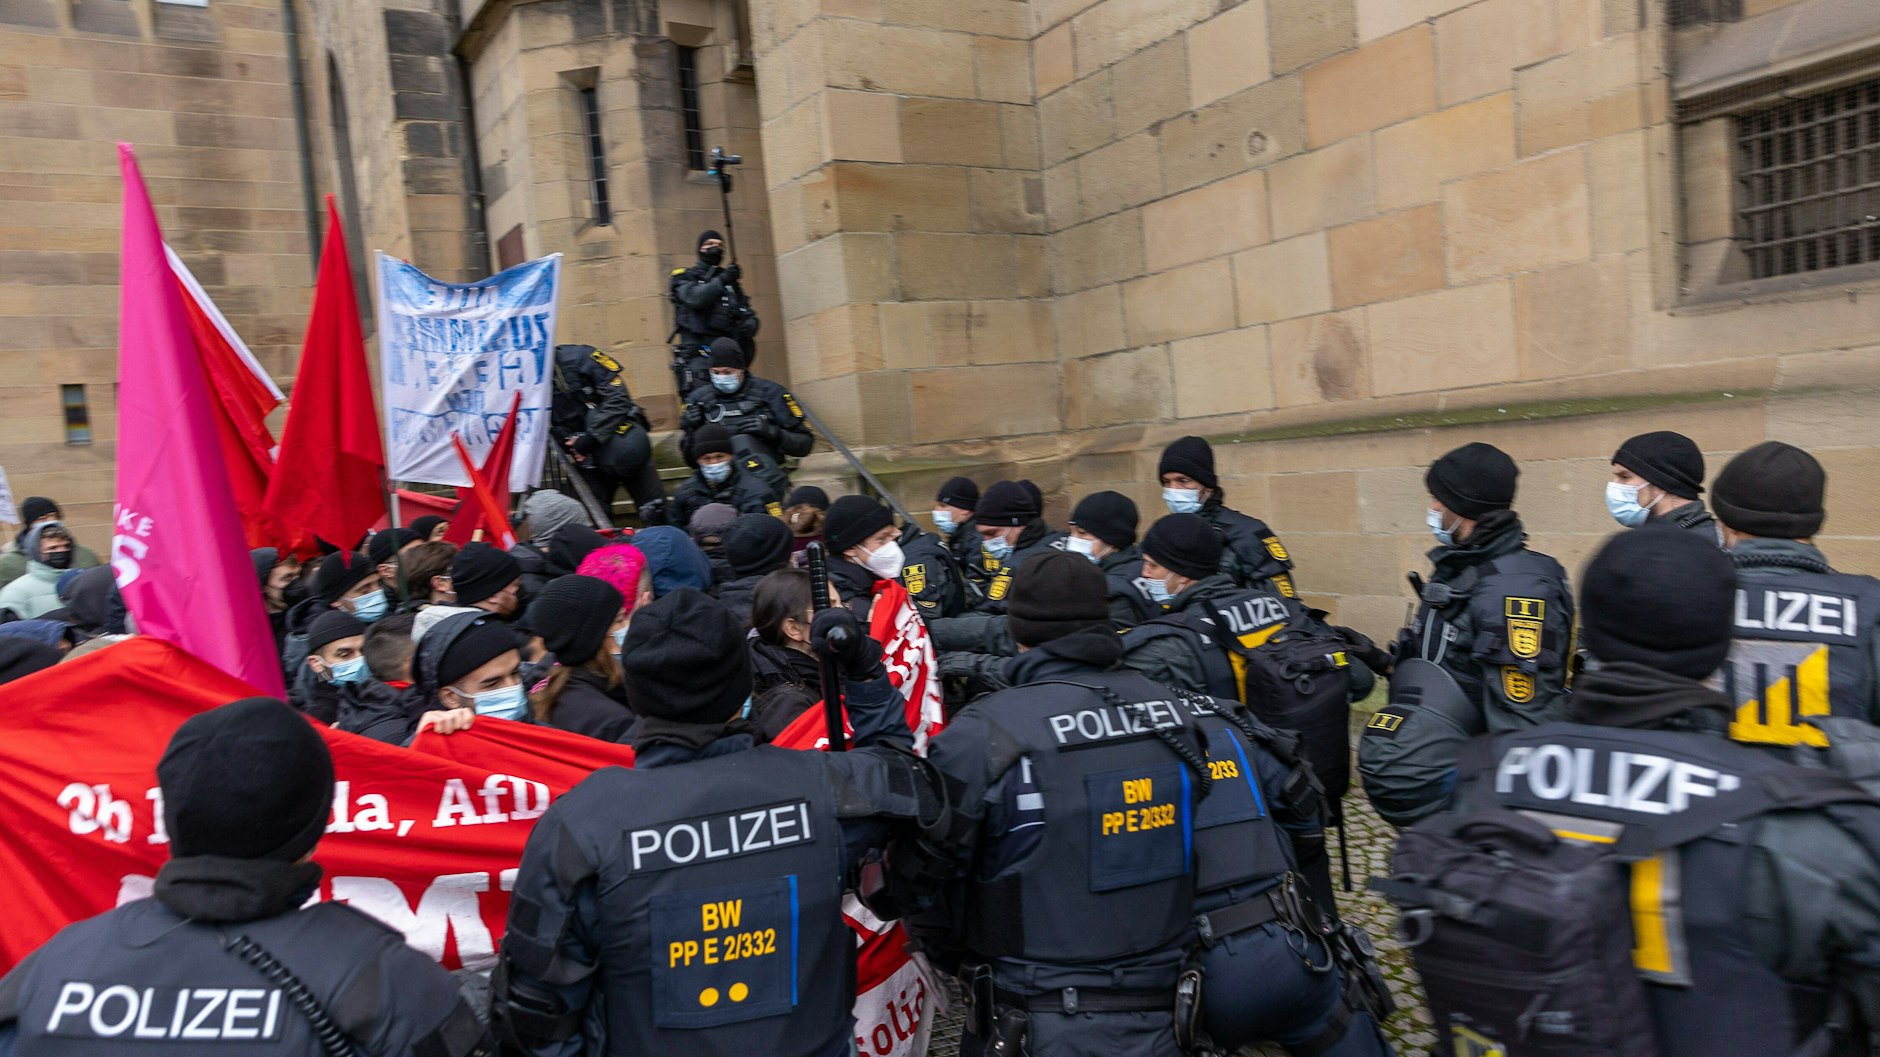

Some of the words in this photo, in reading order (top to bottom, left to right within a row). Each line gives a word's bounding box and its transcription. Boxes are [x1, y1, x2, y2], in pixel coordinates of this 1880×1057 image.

[1734, 589, 1857, 637] LIZEI
[1049, 700, 1183, 743] POLIZEI
[1122, 777, 1152, 804] BW
[1496, 744, 1741, 815] POLIZE
[630, 803, 811, 870] POLIZEI
[701, 899, 742, 932] BW
[669, 940, 697, 968] PP
[704, 935, 718, 965] E
[723, 928, 776, 962] 2/332
[47, 982, 282, 1038] POLIZEI
